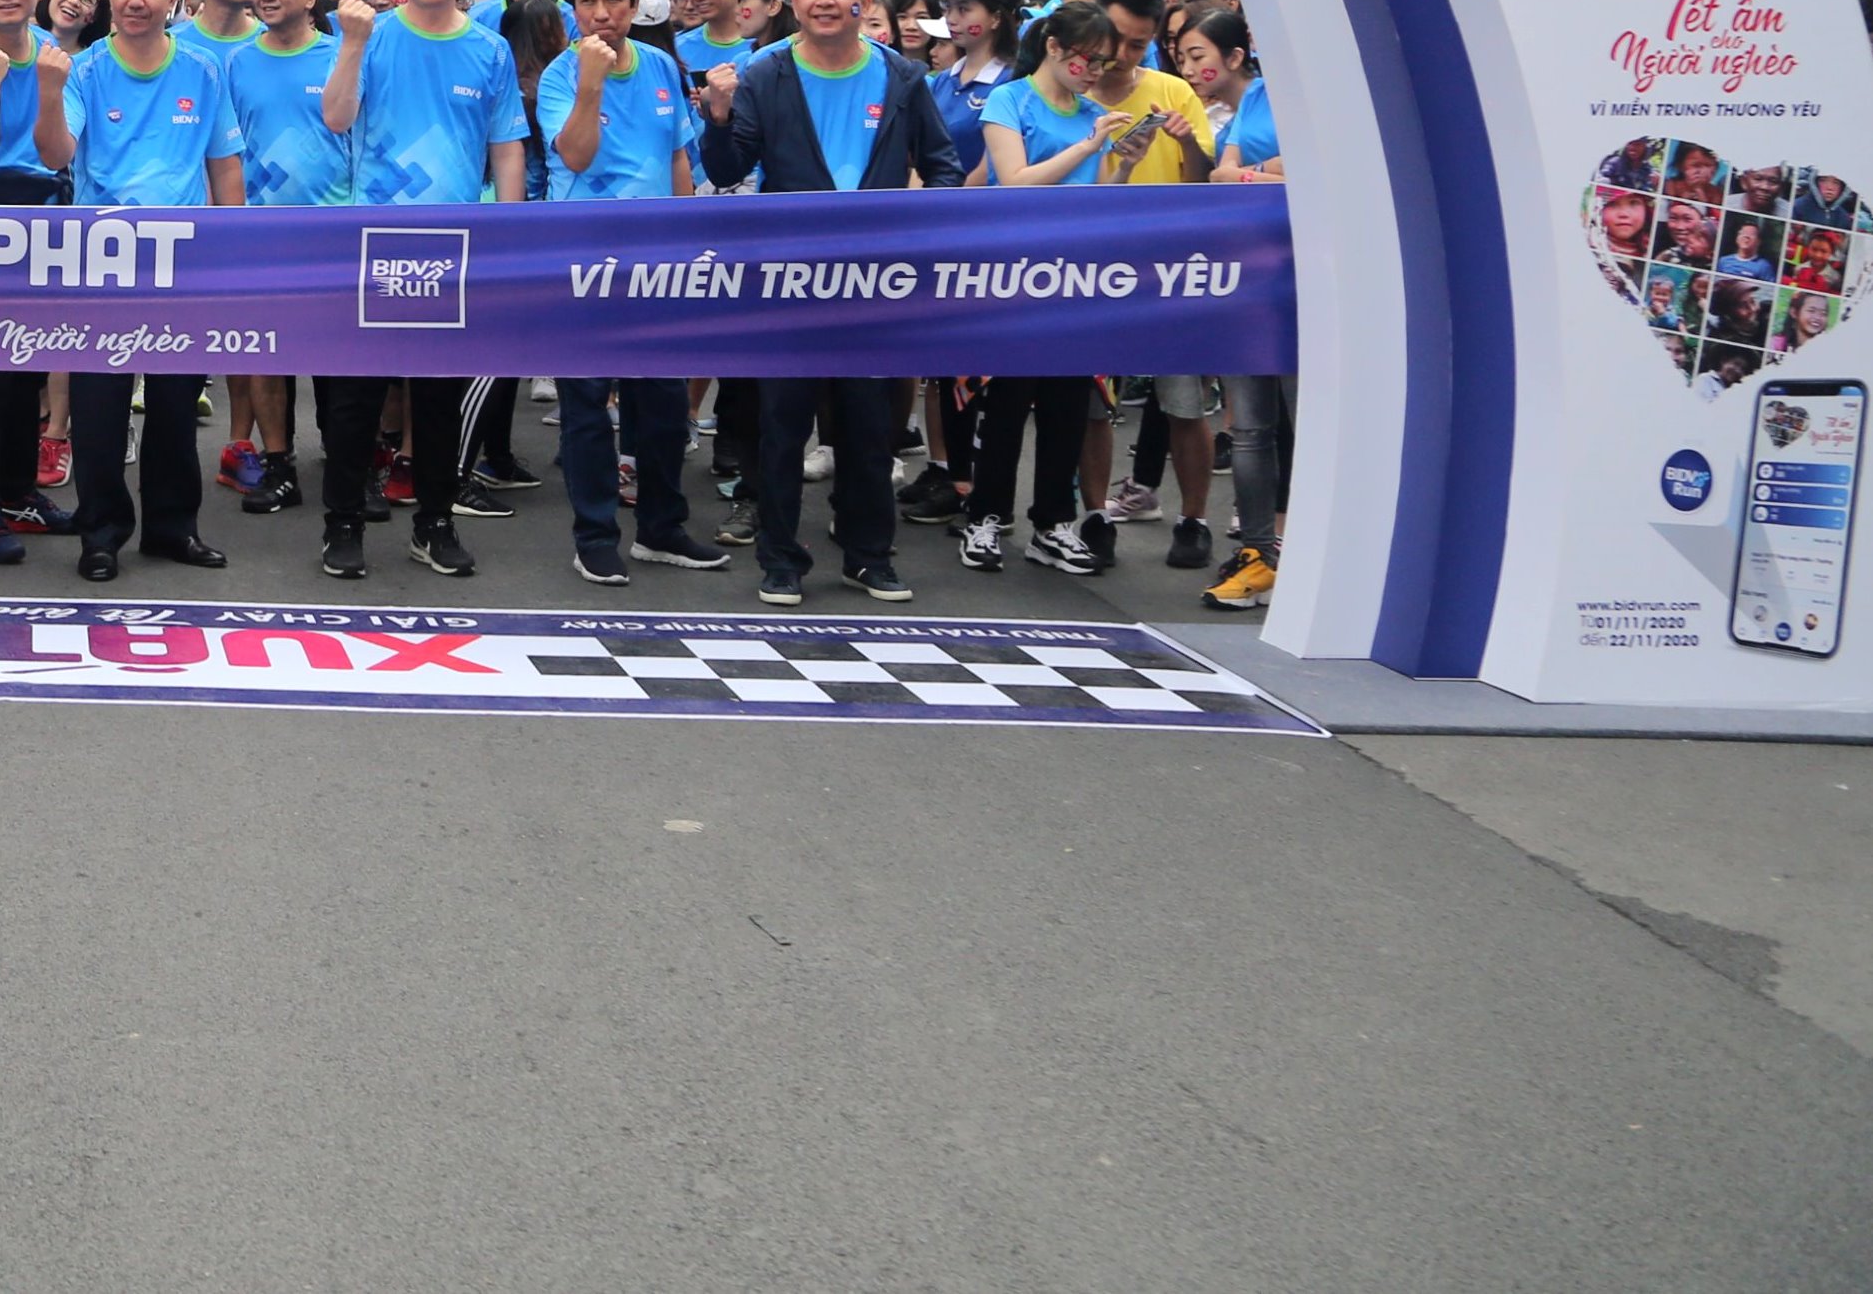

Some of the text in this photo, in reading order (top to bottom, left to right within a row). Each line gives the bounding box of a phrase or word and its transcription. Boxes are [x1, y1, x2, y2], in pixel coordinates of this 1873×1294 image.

[1710, 29, 1746, 49] cho
[1611, 30, 1799, 93] Người nghèo
[453, 85, 475, 96] BIDV
[1590, 97, 1821, 117] VÌ MIỀN TRUNG THƯƠNG YÊU
[172, 115, 194, 124] BIDV
[371, 259, 431, 279] BIDV
[570, 250, 1242, 300] VÌ MIỀN TRUNG THƯƠNG YÊU
[386, 276, 440, 298] Run
[96, 315, 195, 367] nghèo
[205, 330, 279, 355] 2021
[1665, 466, 1696, 482] BIDV
[1672, 481, 1702, 498] Run
[1577, 600, 1701, 611] www.bidvrun.com
[736, 623, 860, 636] CHUNG
[1595, 616, 1686, 629] 01/11/2020
[1609, 634, 1700, 647] 22/11/2020
